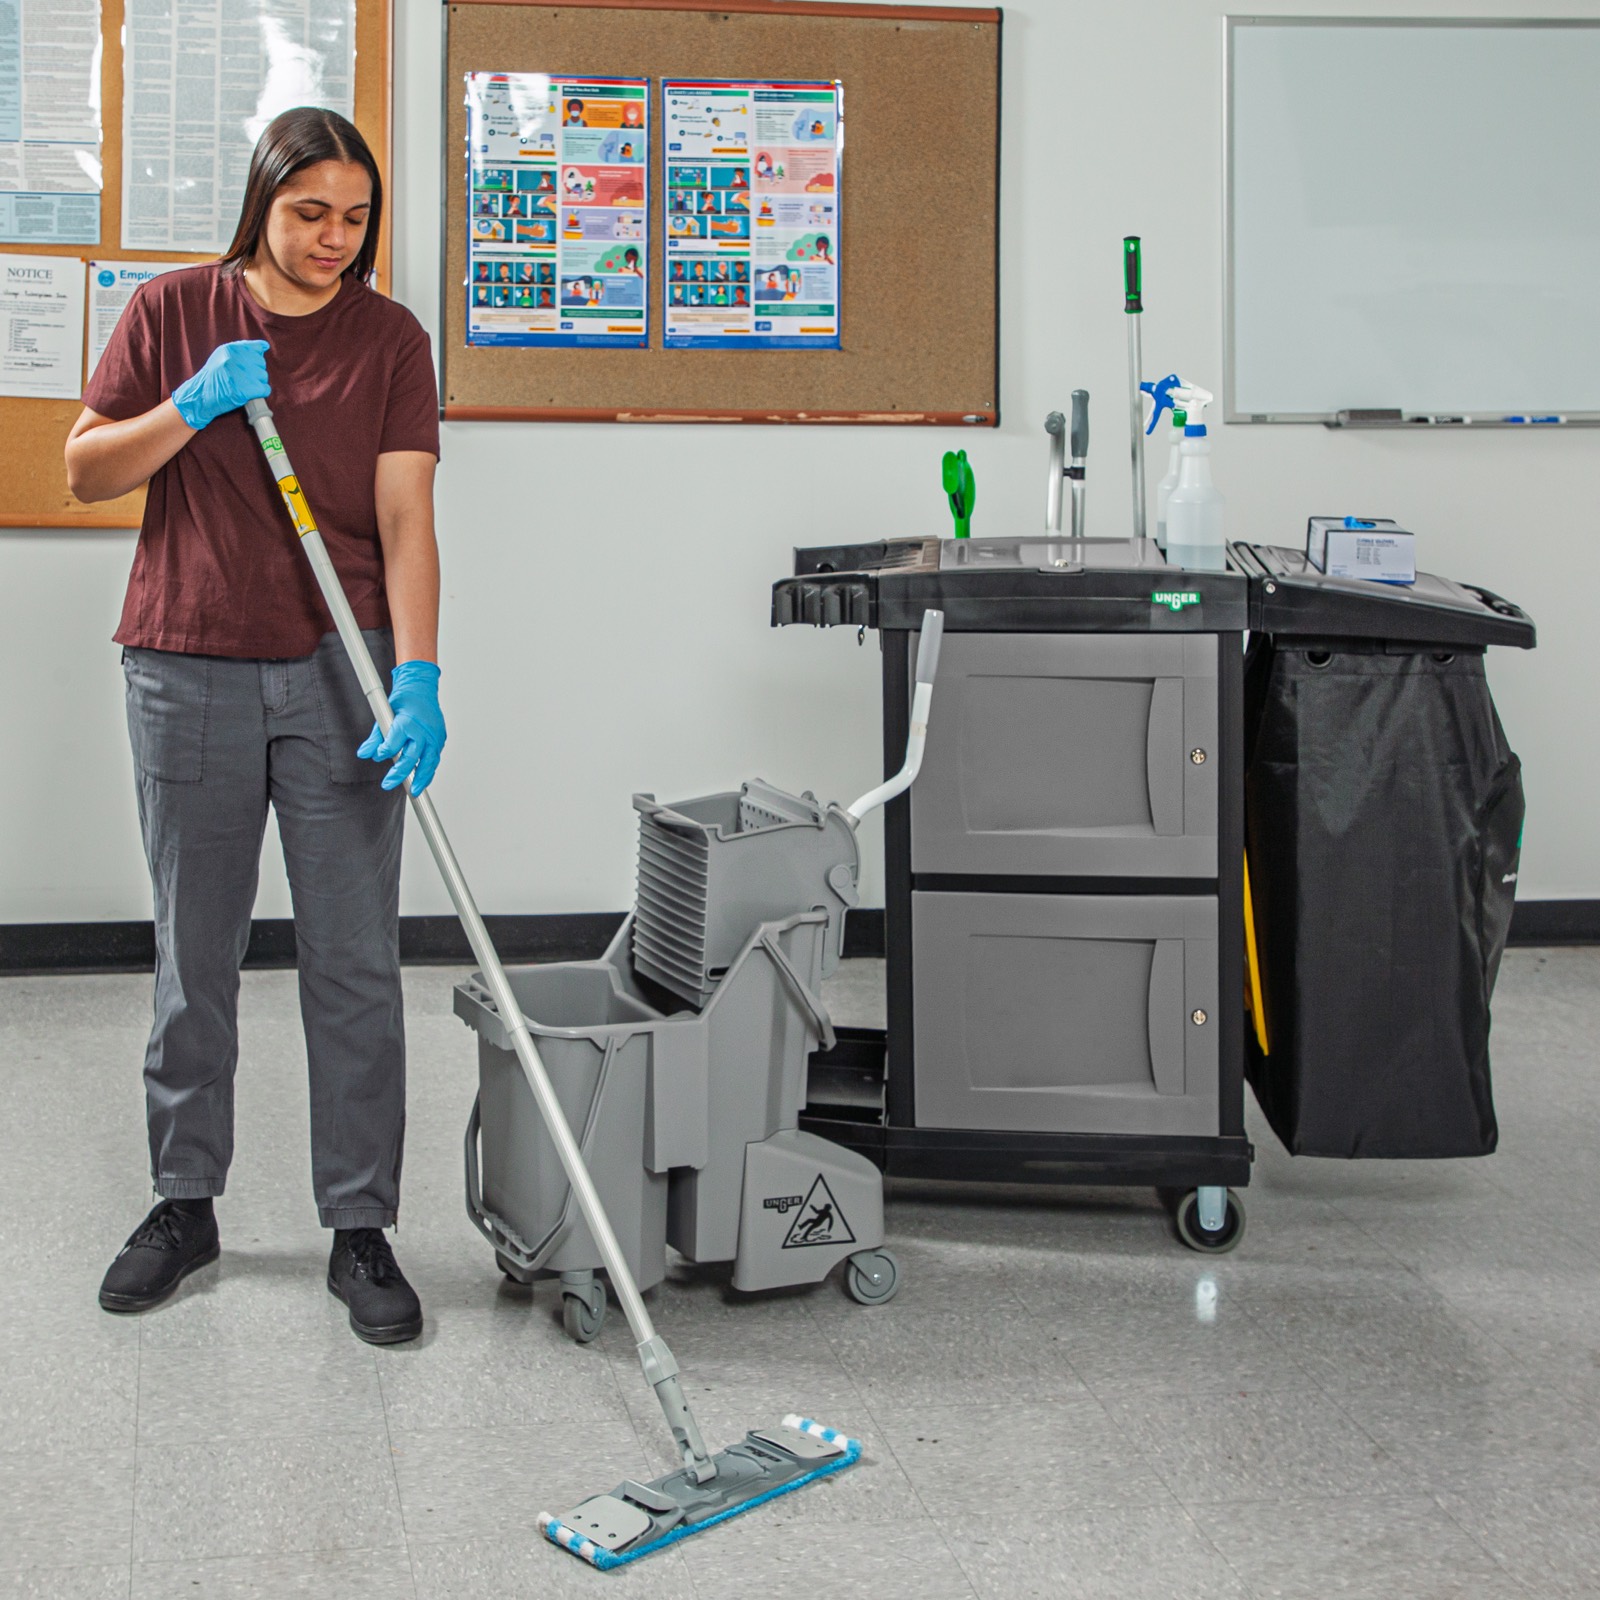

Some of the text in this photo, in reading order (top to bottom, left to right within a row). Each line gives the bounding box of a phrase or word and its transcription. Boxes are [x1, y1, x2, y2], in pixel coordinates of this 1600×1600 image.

[7, 267, 53, 280] NOTICE
[1155, 592, 1197, 609] UNGER
[765, 1197, 801, 1211] UNGER
